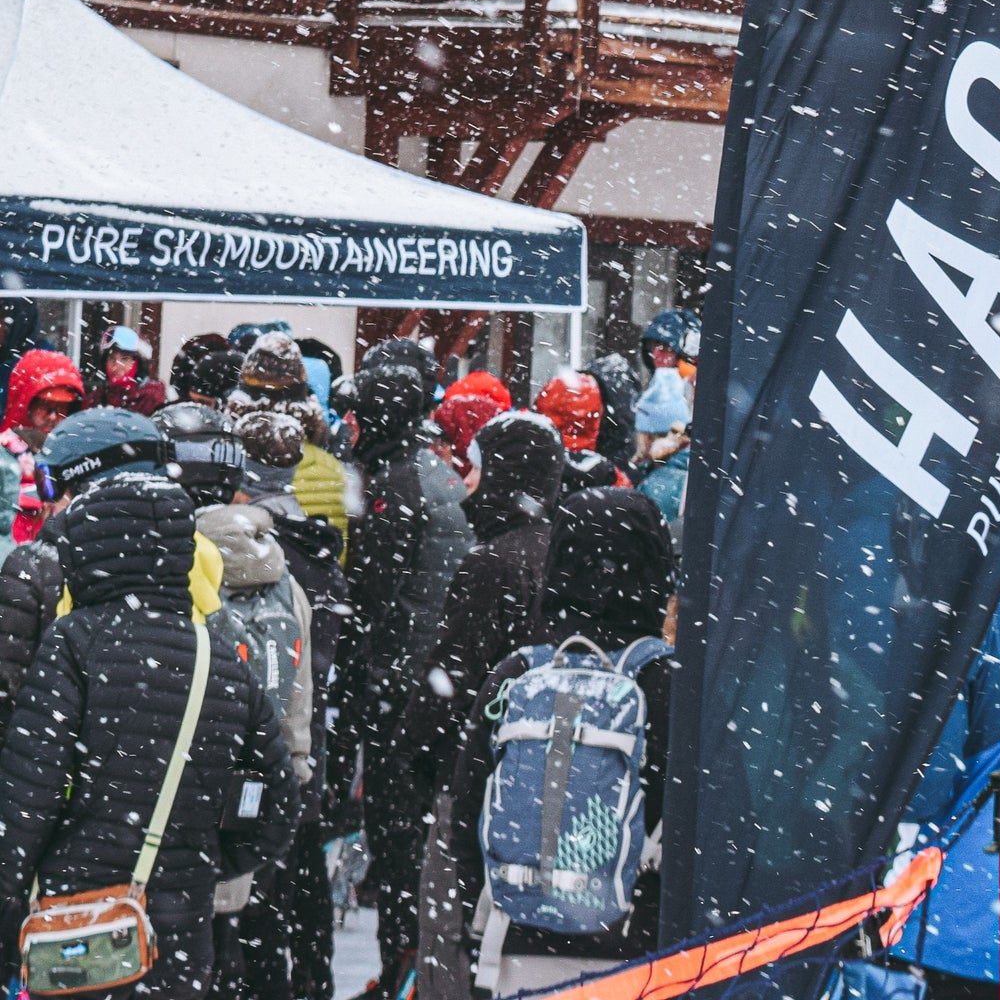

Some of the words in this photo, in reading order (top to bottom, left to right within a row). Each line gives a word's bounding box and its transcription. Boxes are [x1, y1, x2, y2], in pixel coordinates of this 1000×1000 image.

[41, 224, 143, 265] PURE
[150, 229, 211, 267] SKI
[219, 232, 513, 278] MOUNTAINEERING
[61, 456, 102, 480] SMITH
